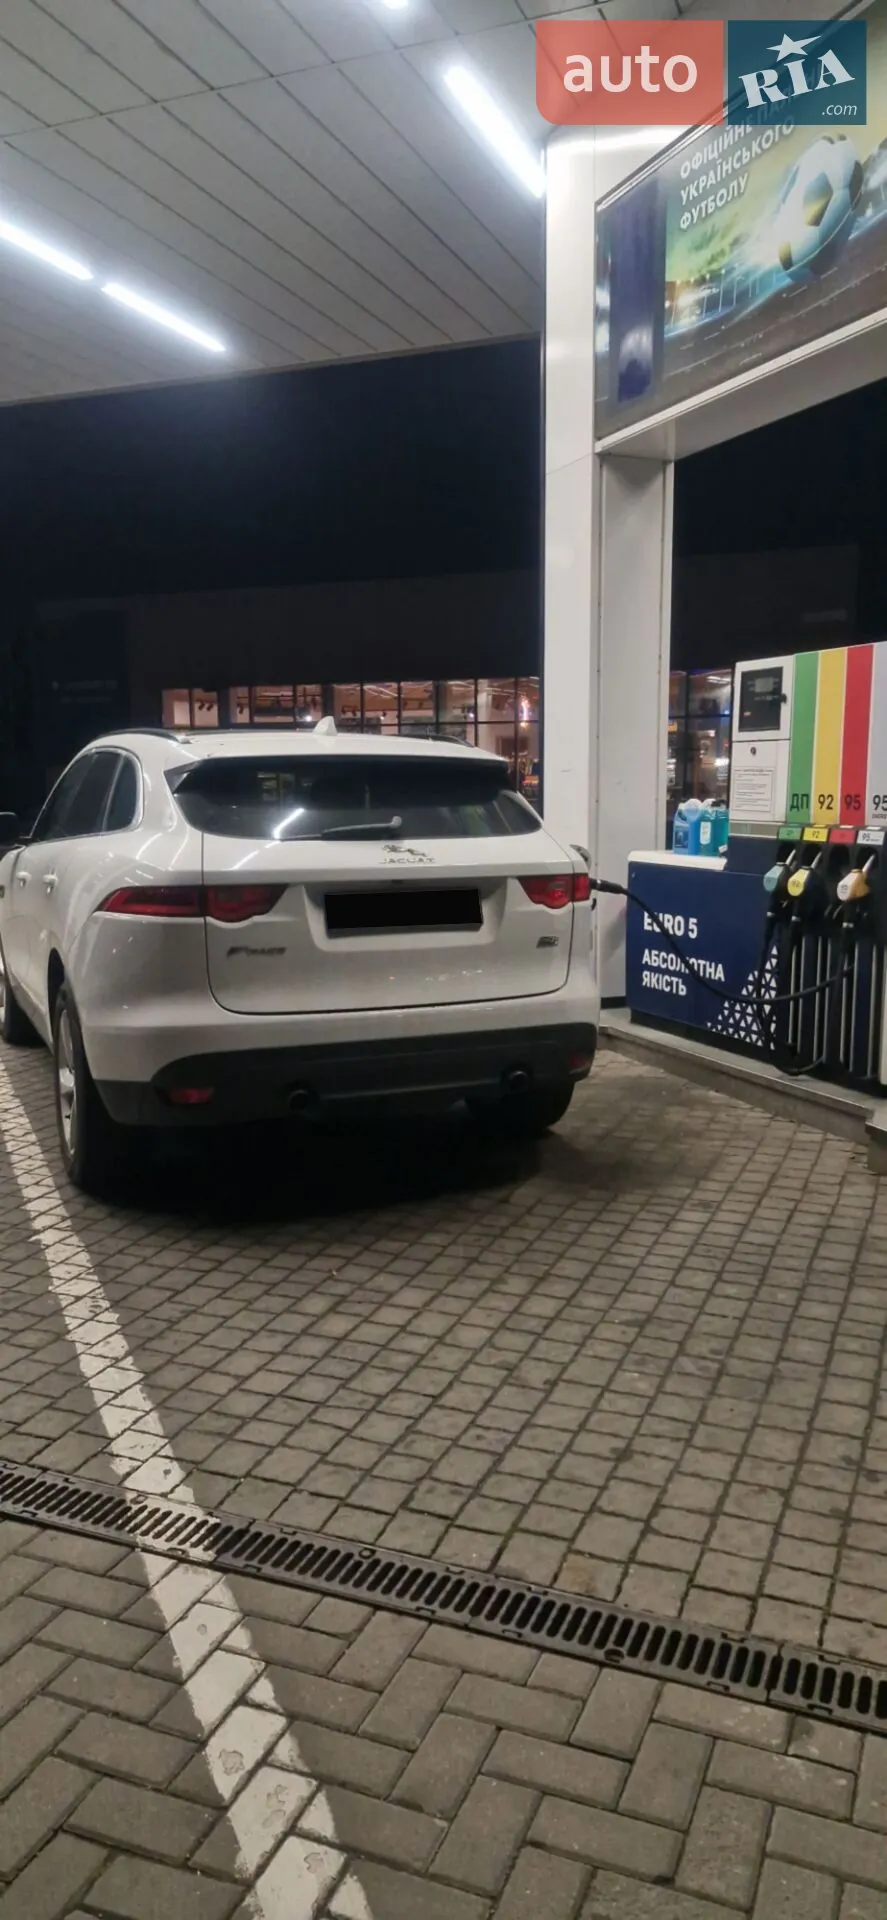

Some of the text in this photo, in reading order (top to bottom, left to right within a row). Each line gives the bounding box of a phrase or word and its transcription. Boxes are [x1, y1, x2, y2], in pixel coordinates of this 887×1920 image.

[680, 113, 753, 179] ОФІЦІЙНЕ
[680, 115, 796, 205] УКРАЇНСЬКОГО
[679, 172, 750, 231] ФУТБОЛУ
[790, 793, 809, 812] ДП
[818, 794, 834, 810] 92
[845, 794, 862, 811] 95
[812, 831, 820, 839] 92
[643, 911, 698, 939] EURO 5
[642, 970, 687, 996] ЯКІСТЬ
